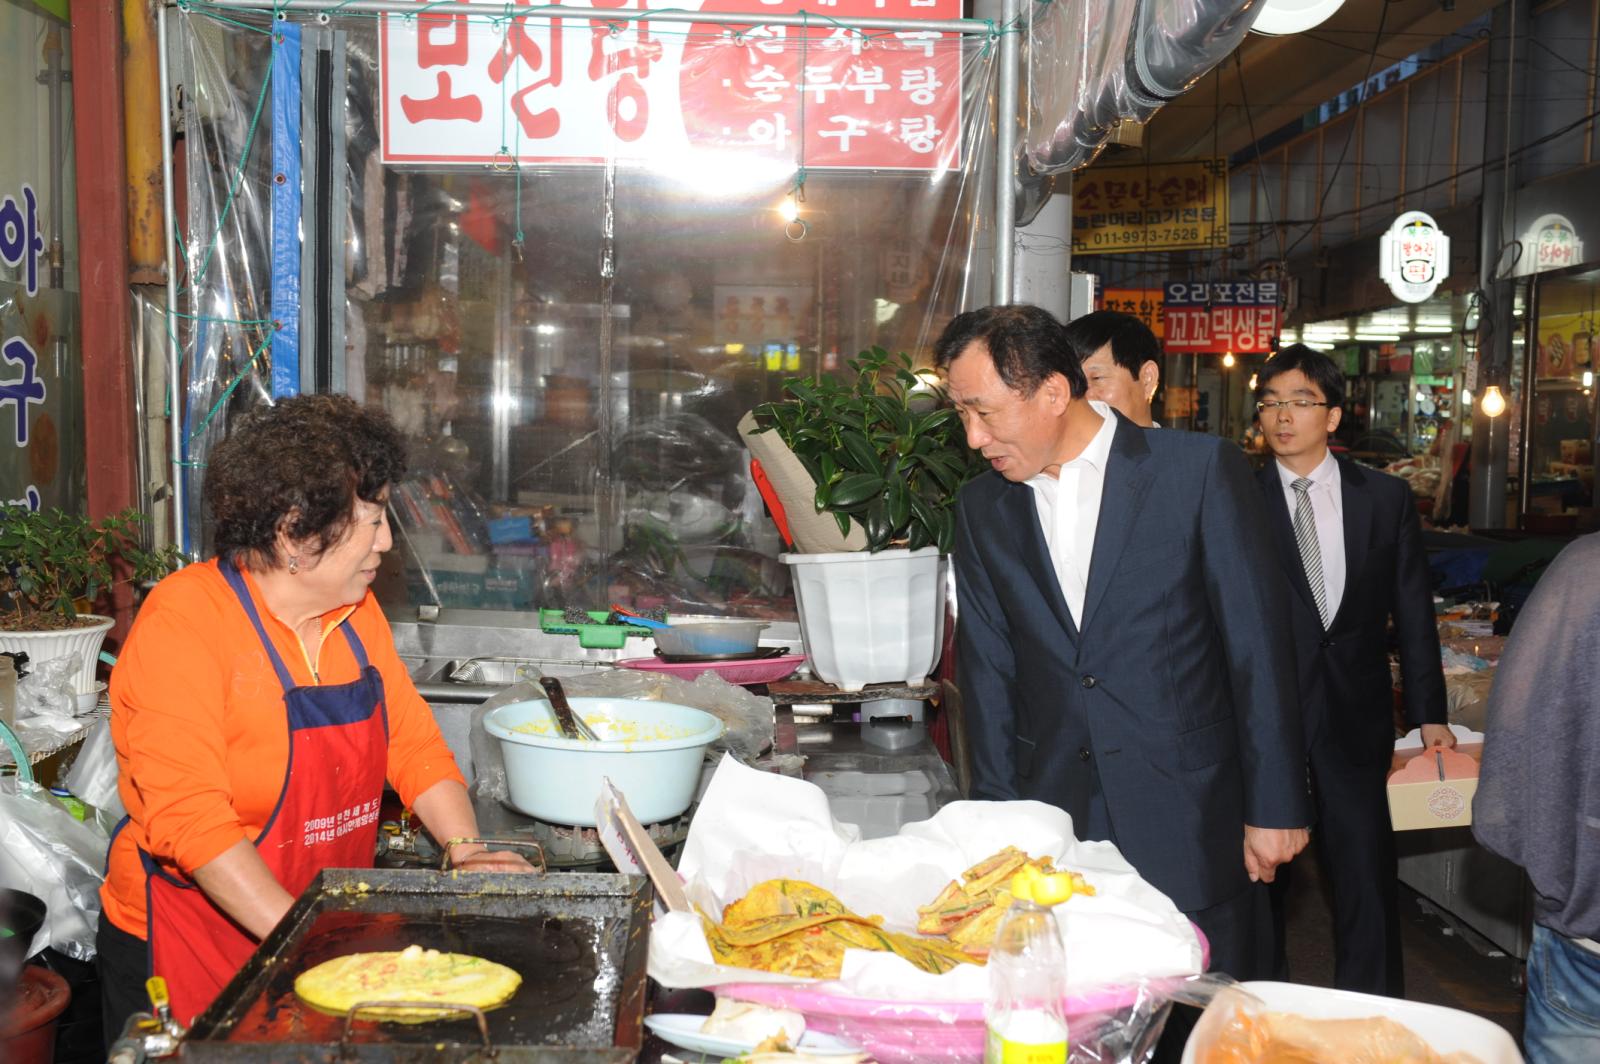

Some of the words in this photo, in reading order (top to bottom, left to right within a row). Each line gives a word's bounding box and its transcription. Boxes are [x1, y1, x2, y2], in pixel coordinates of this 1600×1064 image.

[744, 65, 943, 105] 순두부탕
[1094, 229, 1199, 246] 011-9973-7526
[1167, 308, 1278, 351] 꼬꼬댁생닭
